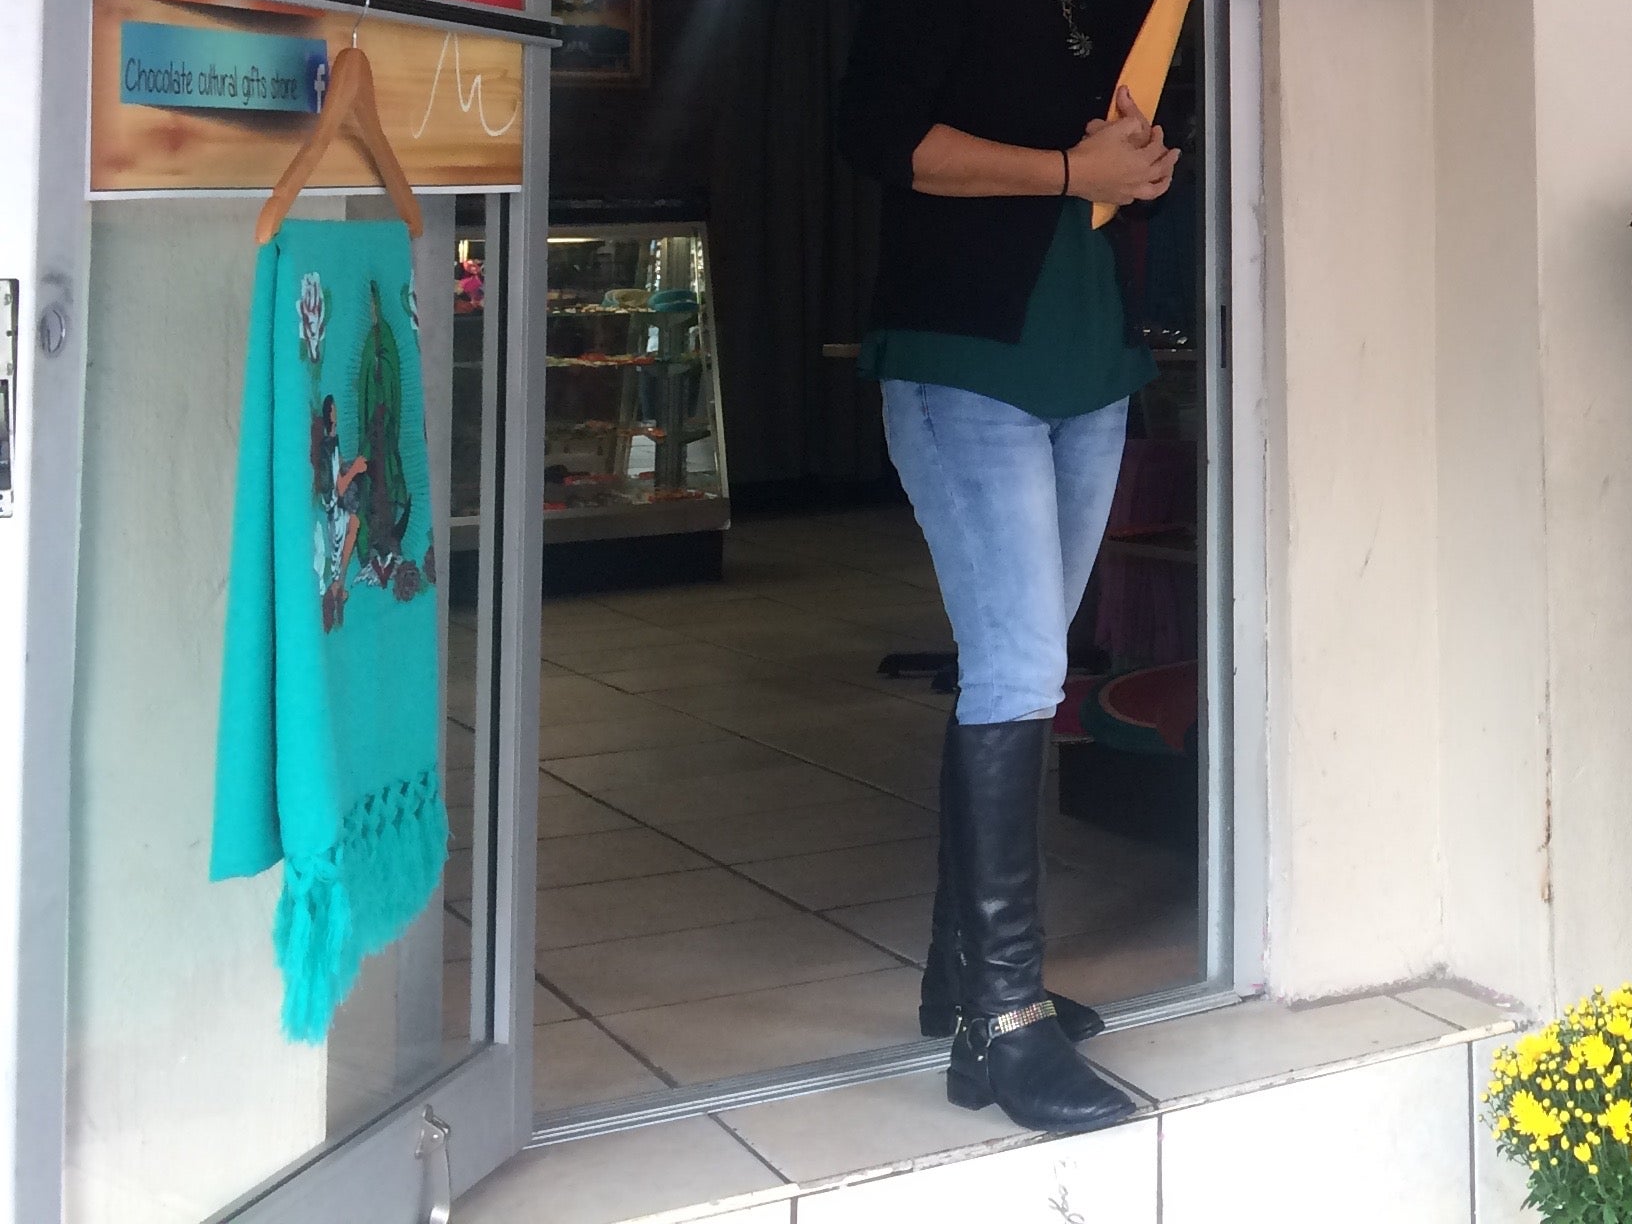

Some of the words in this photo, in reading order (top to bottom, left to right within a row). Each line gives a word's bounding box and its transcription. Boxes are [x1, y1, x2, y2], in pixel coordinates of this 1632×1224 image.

[125, 57, 193, 96] Chocolate
[198, 64, 238, 98] cultural
[241, 65, 267, 106] gifts
[270, 73, 298, 101] store
